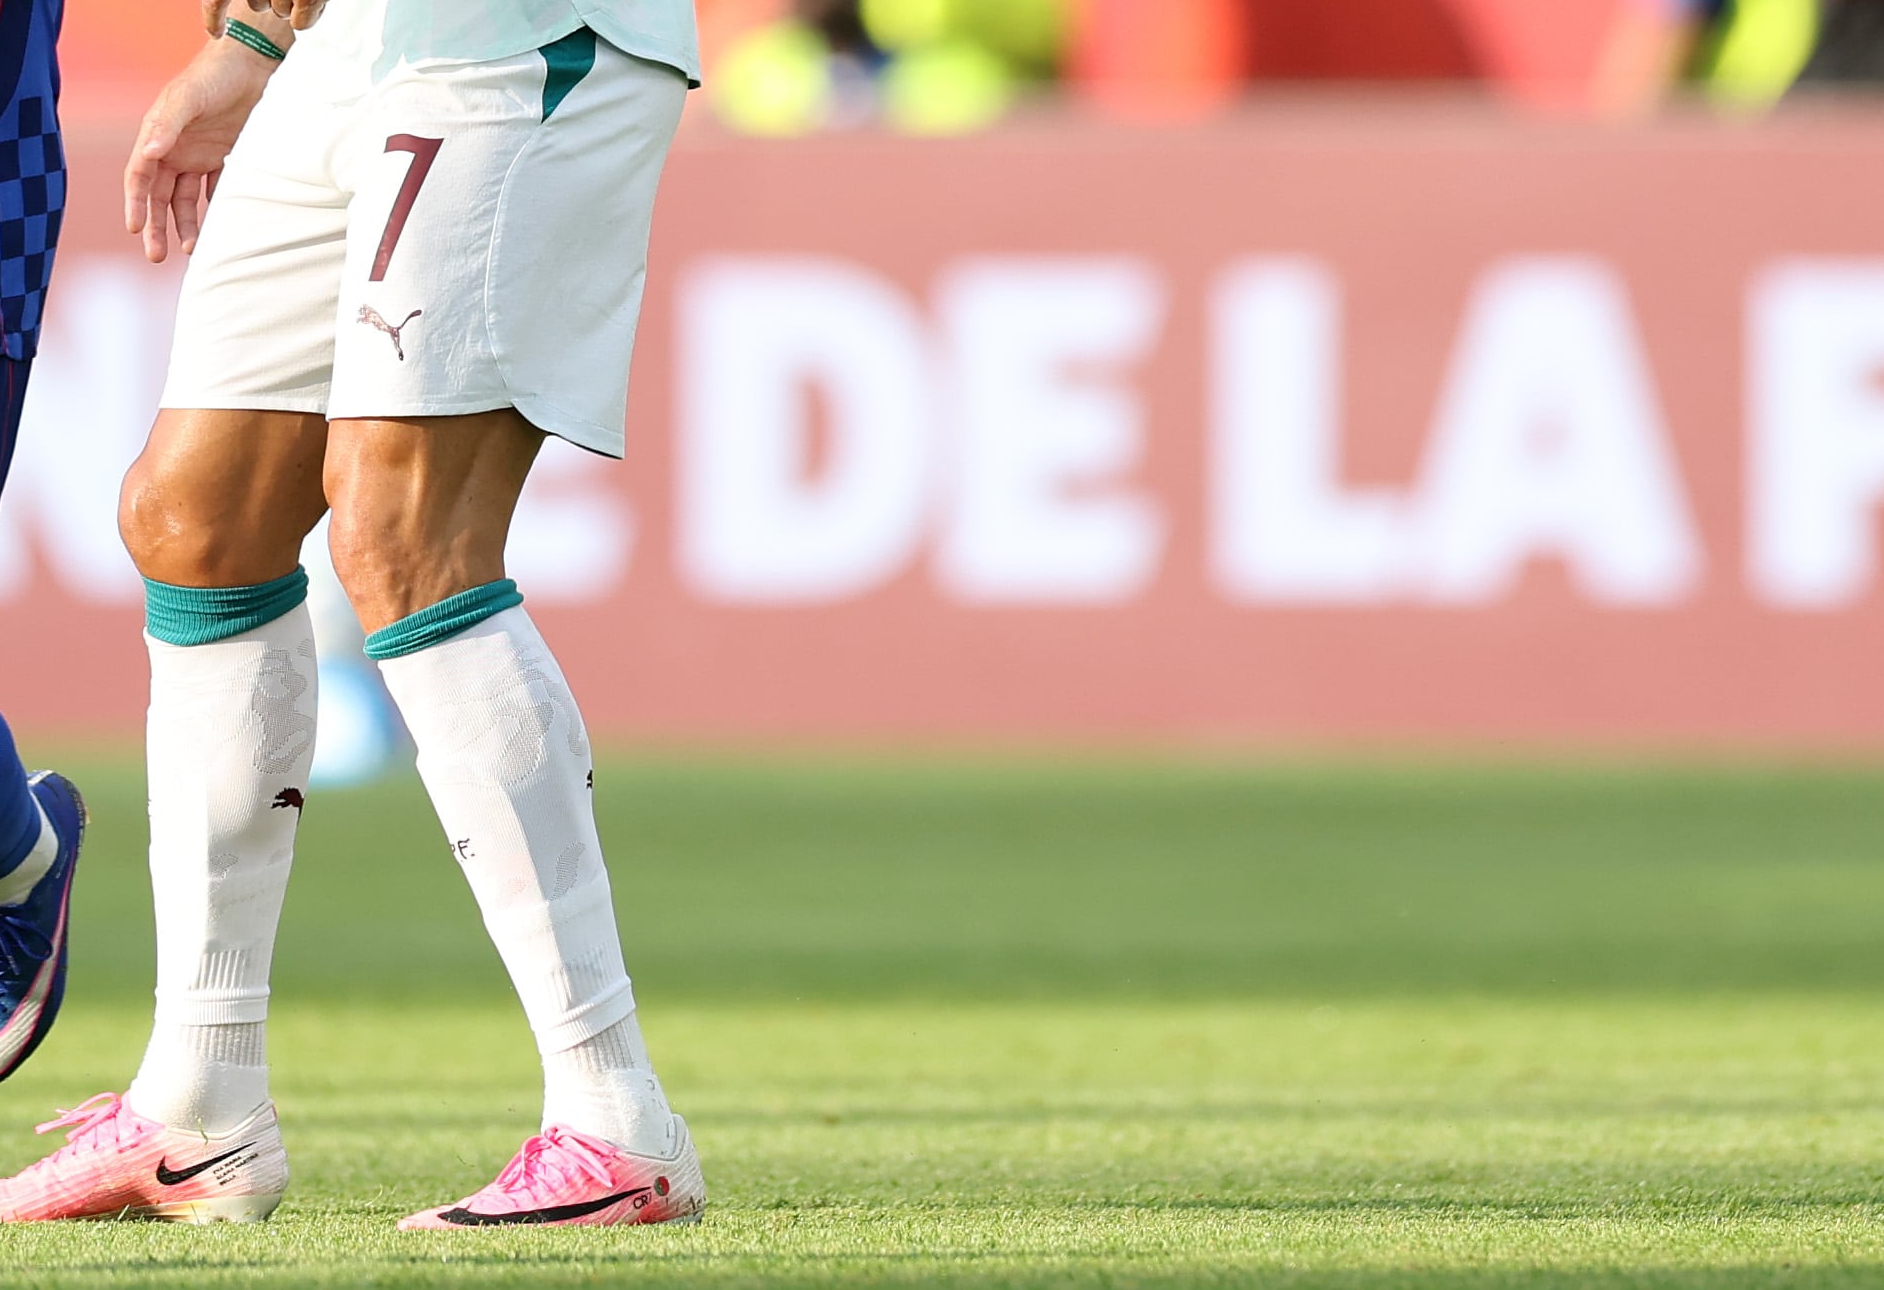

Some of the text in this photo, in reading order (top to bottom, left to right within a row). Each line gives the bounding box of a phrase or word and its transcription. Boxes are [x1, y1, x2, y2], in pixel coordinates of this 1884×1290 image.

[369, 133, 444, 282] 7
[674, 253, 1171, 608] DE
[1204, 253, 1709, 608] LA
[633, 1192, 652, 1209] CR7
